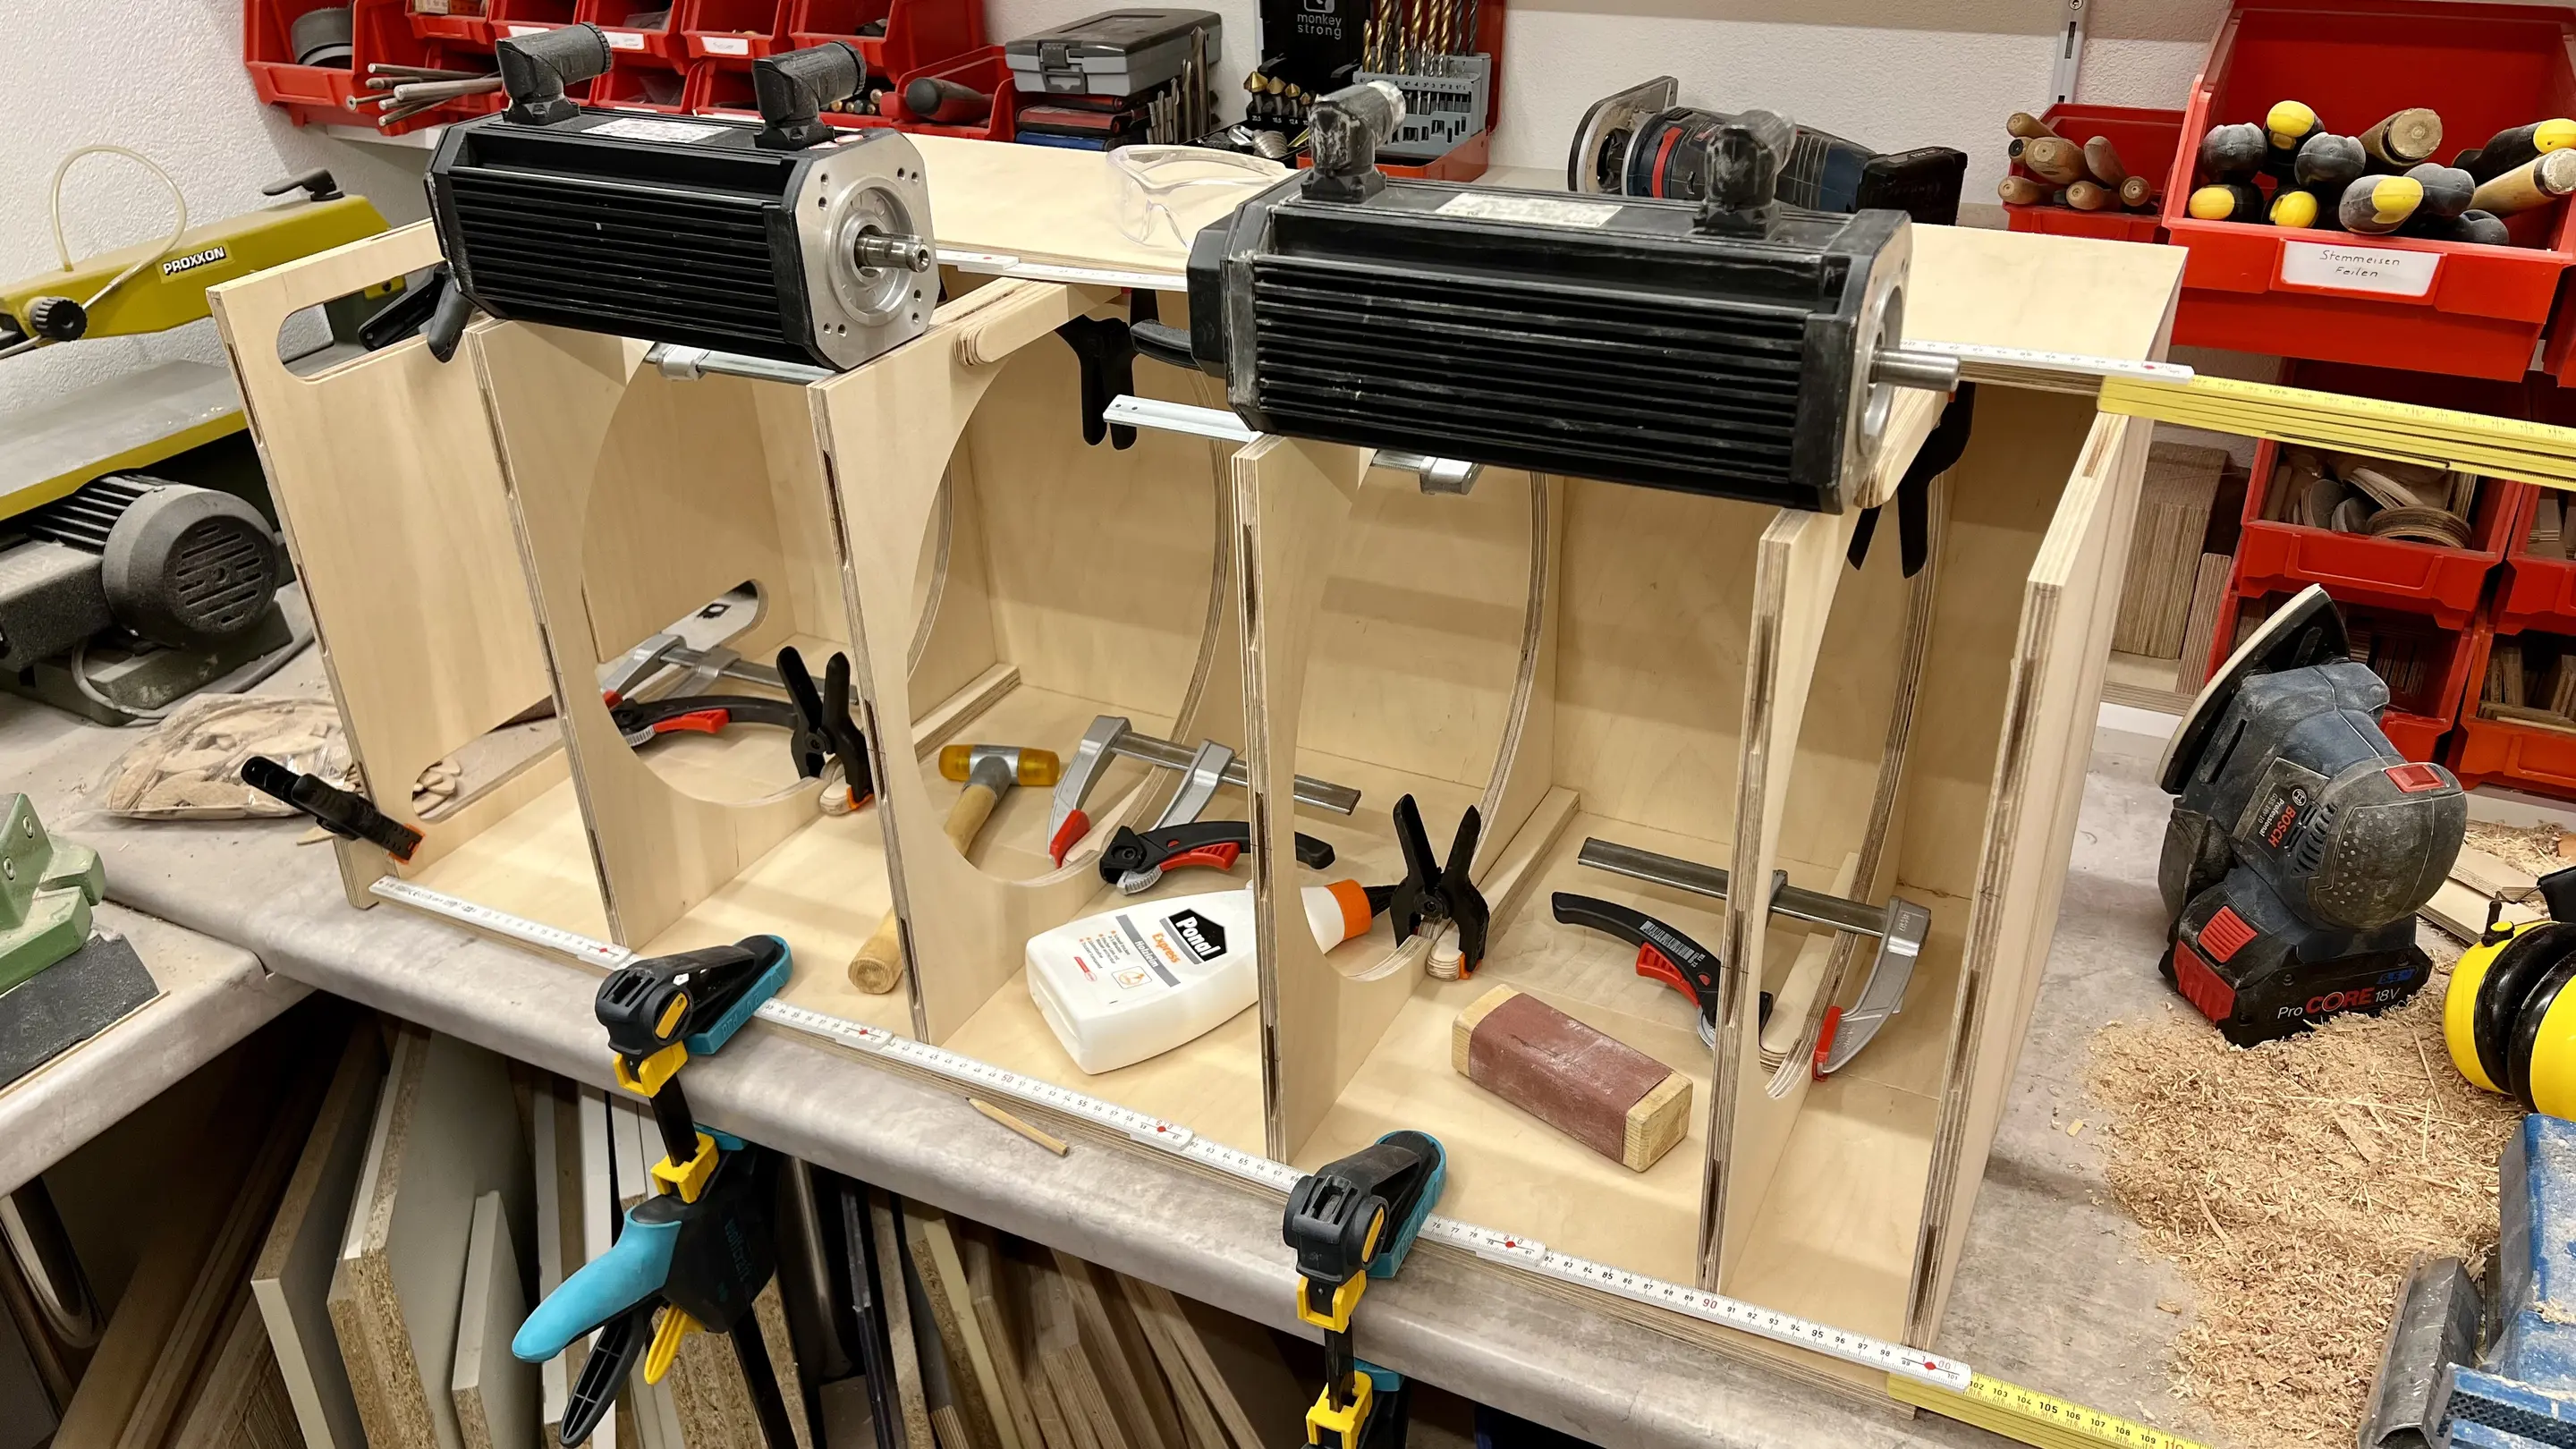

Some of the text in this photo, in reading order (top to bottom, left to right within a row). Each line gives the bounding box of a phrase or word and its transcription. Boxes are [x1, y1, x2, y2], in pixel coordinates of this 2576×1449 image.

[1297, 13, 1342, 28] monkey
[1297, 24, 1342, 40] strong
[163, 246, 226, 275] PROXXON
[2319, 250, 2401, 266] Stemmeisen
[2335, 266, 2378, 277] Feilen
[2258, 798, 2285, 837] Professional
[2267, 806, 2297, 848] BOSCH
[1152, 930, 1182, 964] Express
[1175, 916, 1222, 956] Ponal
[1134, 940, 1159, 968] Holzleim
[2277, 987, 2401, 1020] Pro CORE 18V
[928, 1053, 939, 1061] 45
[1000, 1074, 1014, 1083] 50
[1077, 1099, 1089, 1107] 55
[1223, 1152, 1231, 1160] 64
[1238, 1157, 1249, 1165] 65
[1469, 1231, 1478, 1239] 78
[1602, 1271, 1614, 1280] 85
[1623, 1277, 1633, 1285] 86
[1644, 1283, 1654, 1291] 87
[1664, 1289, 1674, 1297] 88
[1684, 1294, 1694, 1302] 89
[1702, 1299, 1718, 1309] 90
[1746, 1311, 1758, 1320] 92
[1769, 1318, 1779, 1326] 93
[1791, 1324, 1801, 1333] 94
[1812, 1329, 1825, 1339] 95
[1835, 1336, 1846, 1344] 96
[1858, 1342, 1868, 1351] 97
[1880, 1349, 1891, 1358] 98
[1947, 1373, 1958, 1381] 101
[1970, 1381, 1984, 1391] 102
[1993, 1388, 2009, 1398] 103
[2017, 1395, 2032, 1405] 104
[2039, 1402, 2059, 1413] 105
[2066, 1410, 2080, 1420] 106
[2090, 1419, 2106, 1428] 107
[2115, 1426, 2131, 1436] 108
[2140, 1434, 2157, 1445] 109
